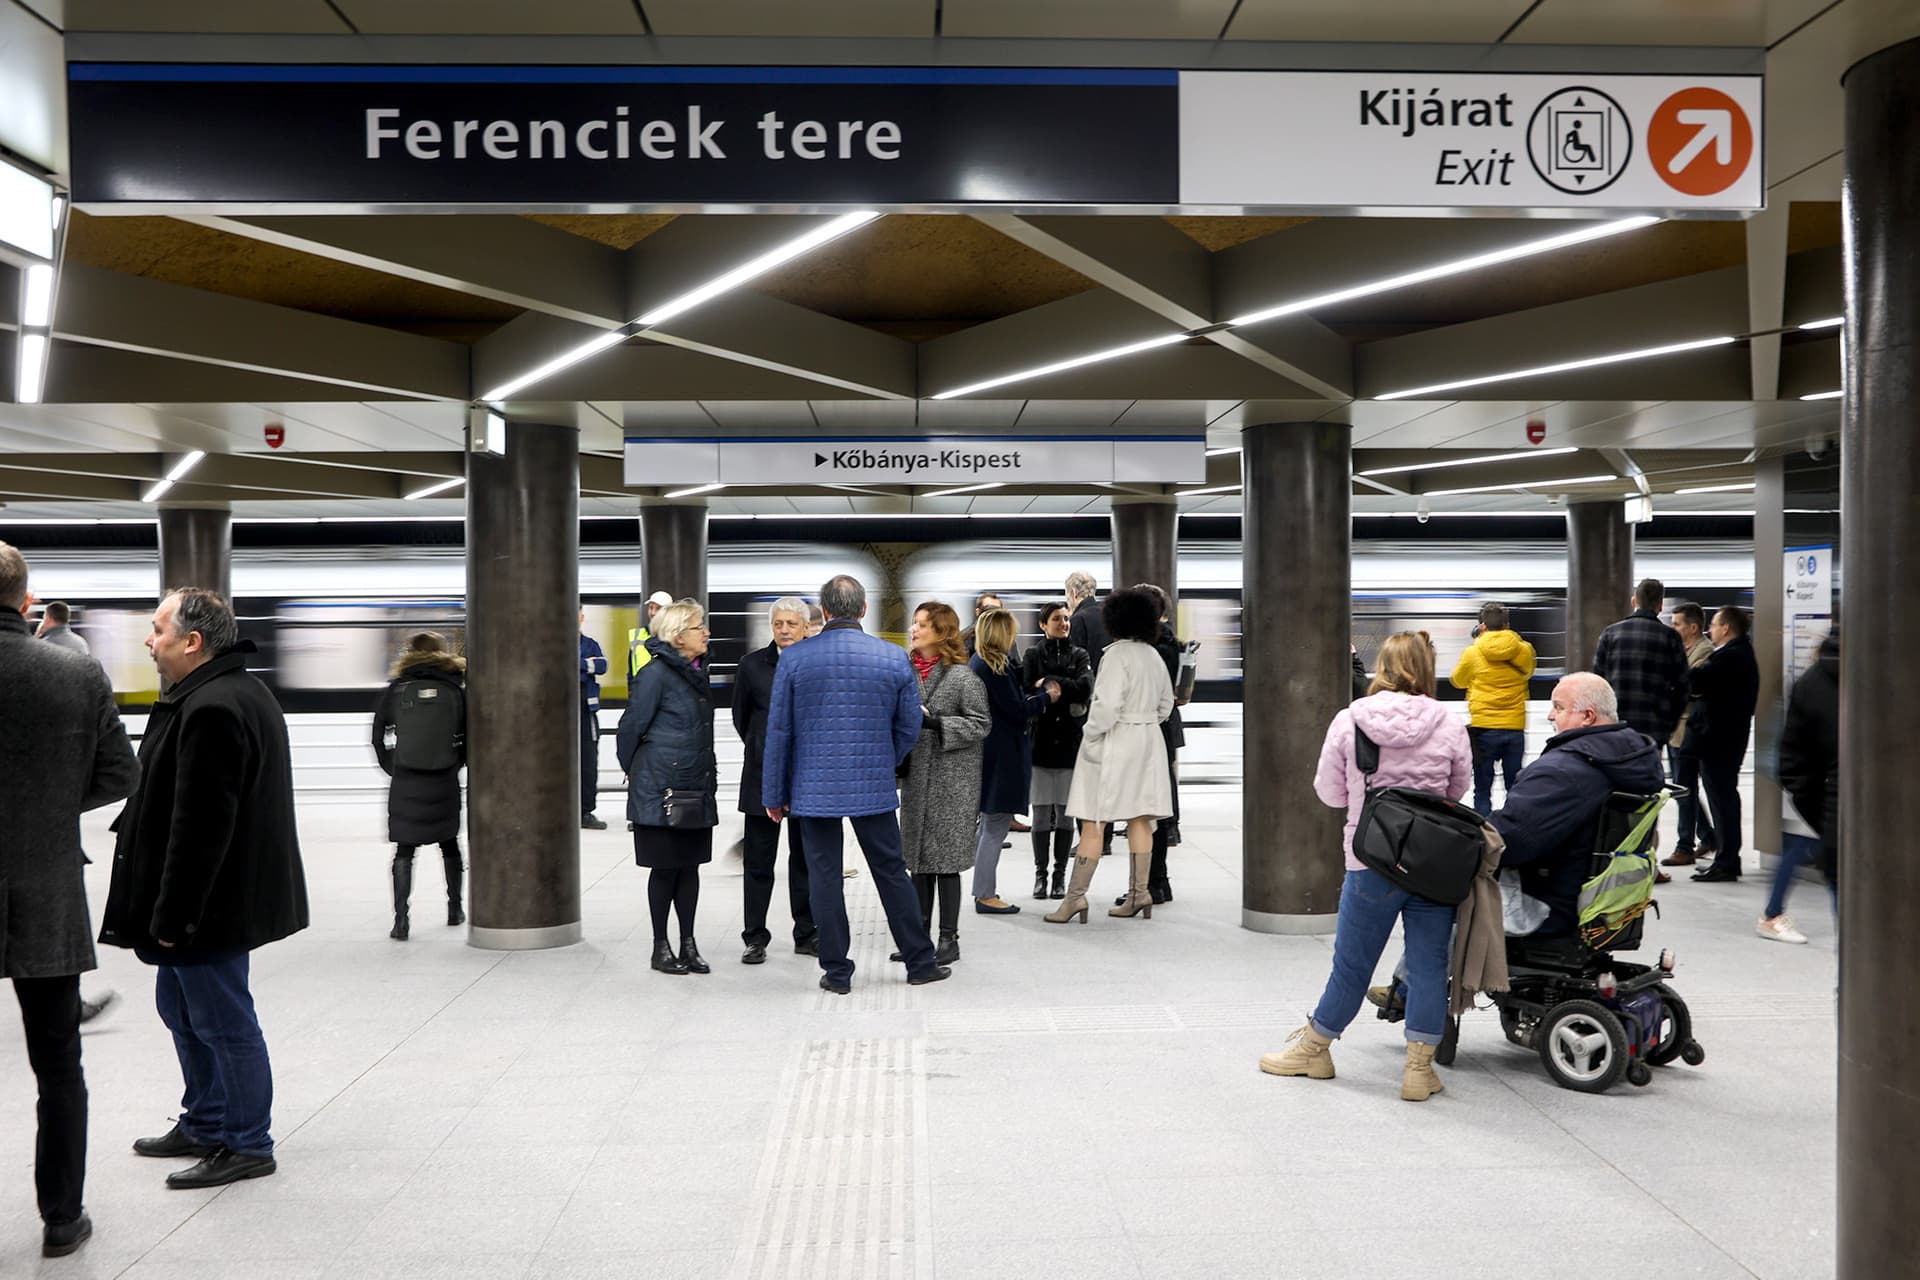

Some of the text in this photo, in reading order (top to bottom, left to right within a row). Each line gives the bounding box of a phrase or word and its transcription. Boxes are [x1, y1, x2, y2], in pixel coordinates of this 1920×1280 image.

[366, 106, 902, 160] Ferenciek tere
[1360, 88, 1514, 138] Kijárat
[1435, 149, 1515, 186] Exit
[833, 449, 1022, 473] Kőbánya-Kispest
